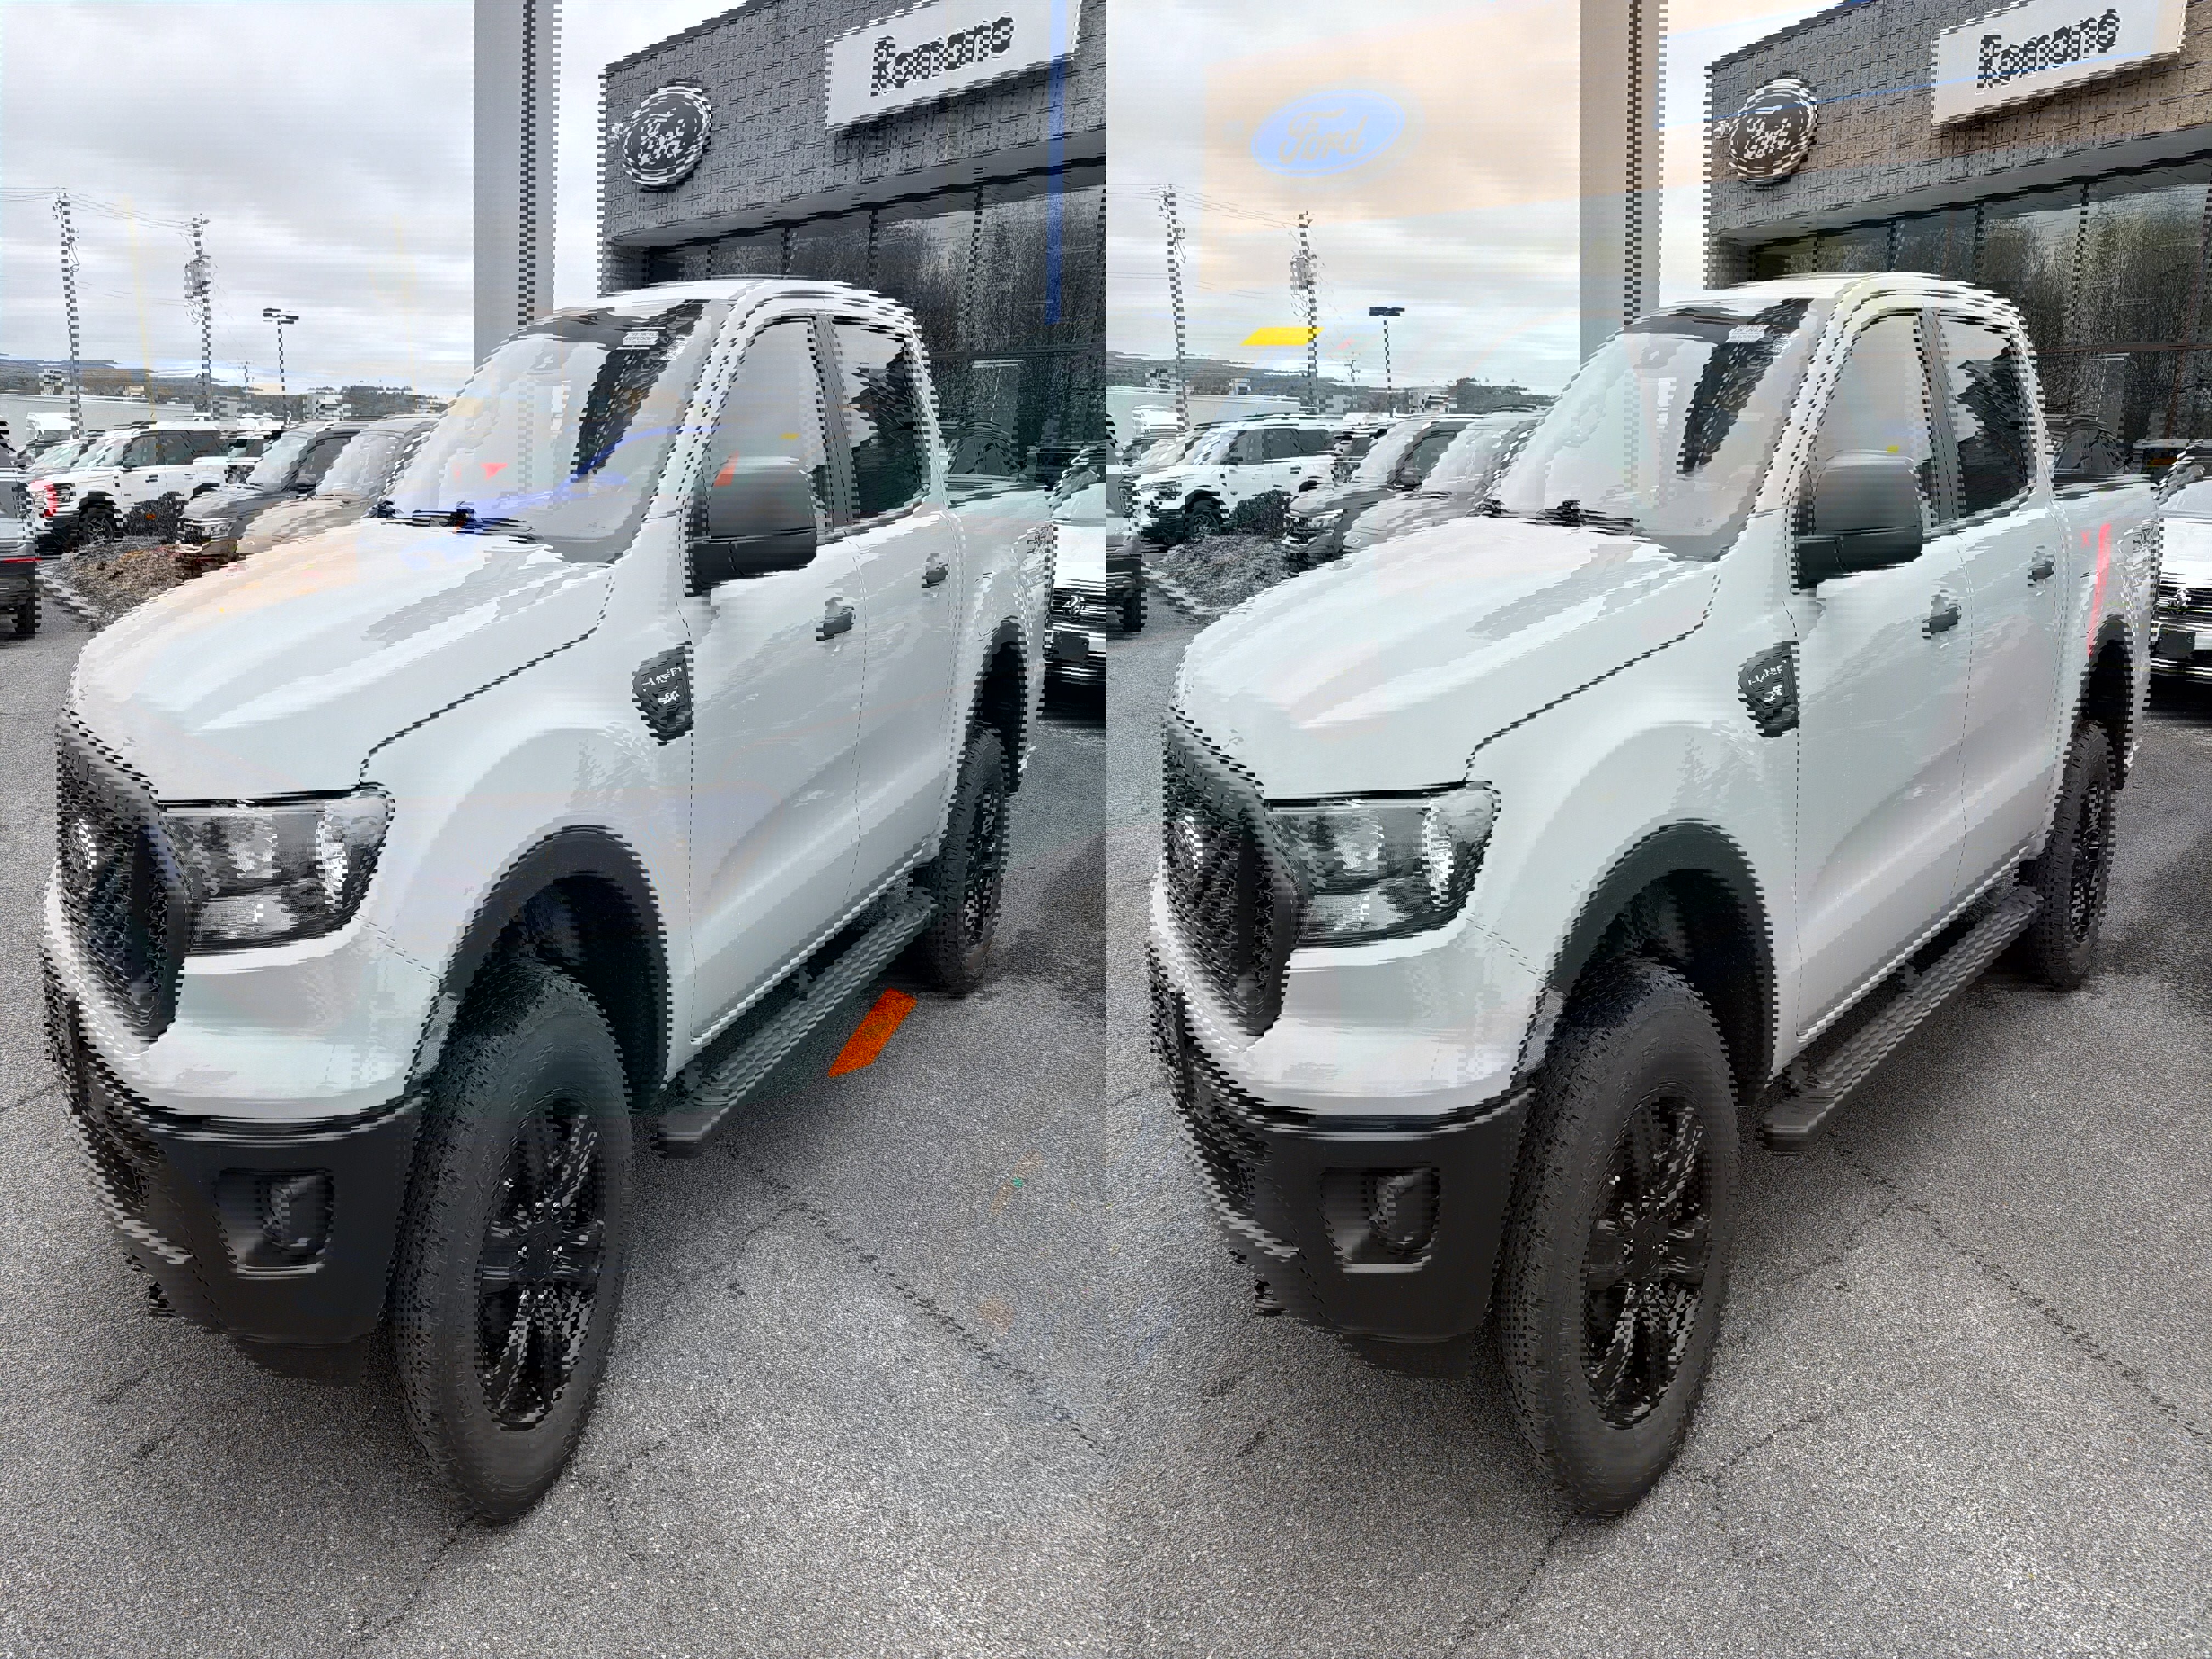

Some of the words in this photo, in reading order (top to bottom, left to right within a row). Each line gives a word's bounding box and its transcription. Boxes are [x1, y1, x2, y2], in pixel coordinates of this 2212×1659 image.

[870, 13, 1015, 97] Romano
[1976, 9, 2120, 89] Romano
[1278, 108, 1369, 165] Ford
